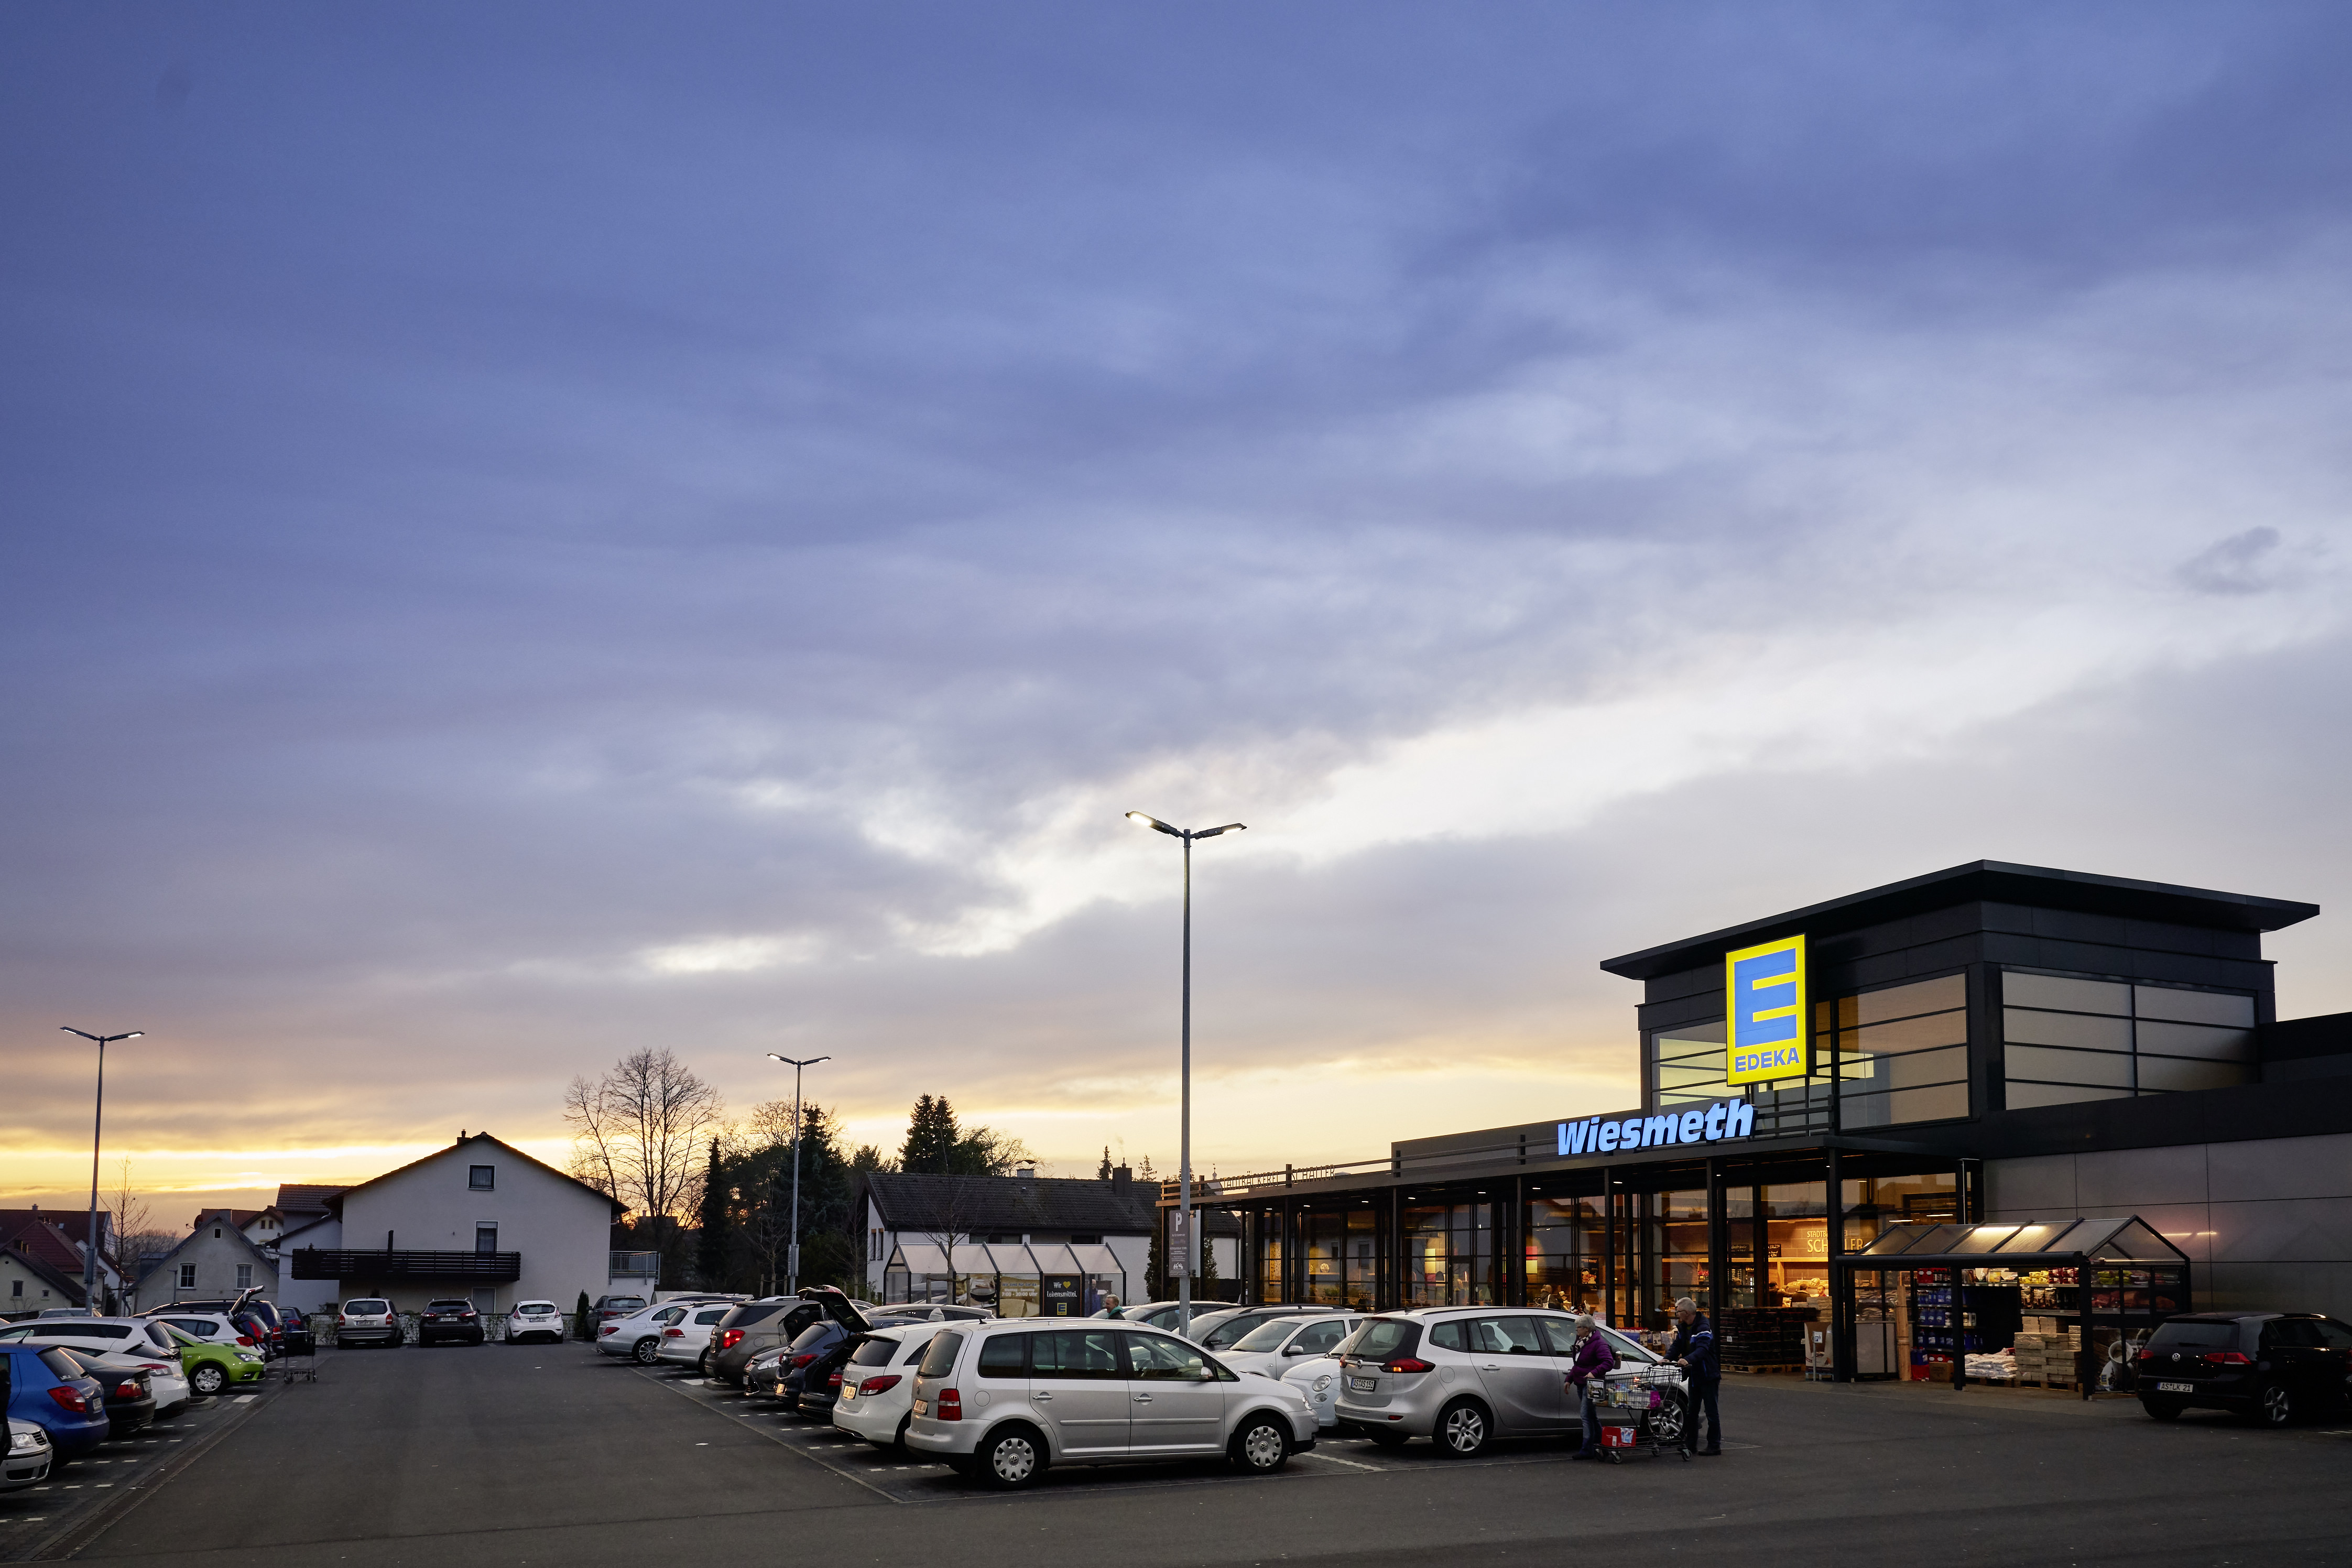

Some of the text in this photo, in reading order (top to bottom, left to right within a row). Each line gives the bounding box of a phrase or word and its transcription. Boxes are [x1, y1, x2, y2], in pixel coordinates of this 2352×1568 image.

[1734, 948, 1797, 1048] E
[1735, 1047, 1800, 1073] EDEKA
[1558, 1098, 1754, 1156] Wiesmeth
[1291, 1164, 1336, 1184] SCHALLER
[1175, 1212, 1183, 1232] P
